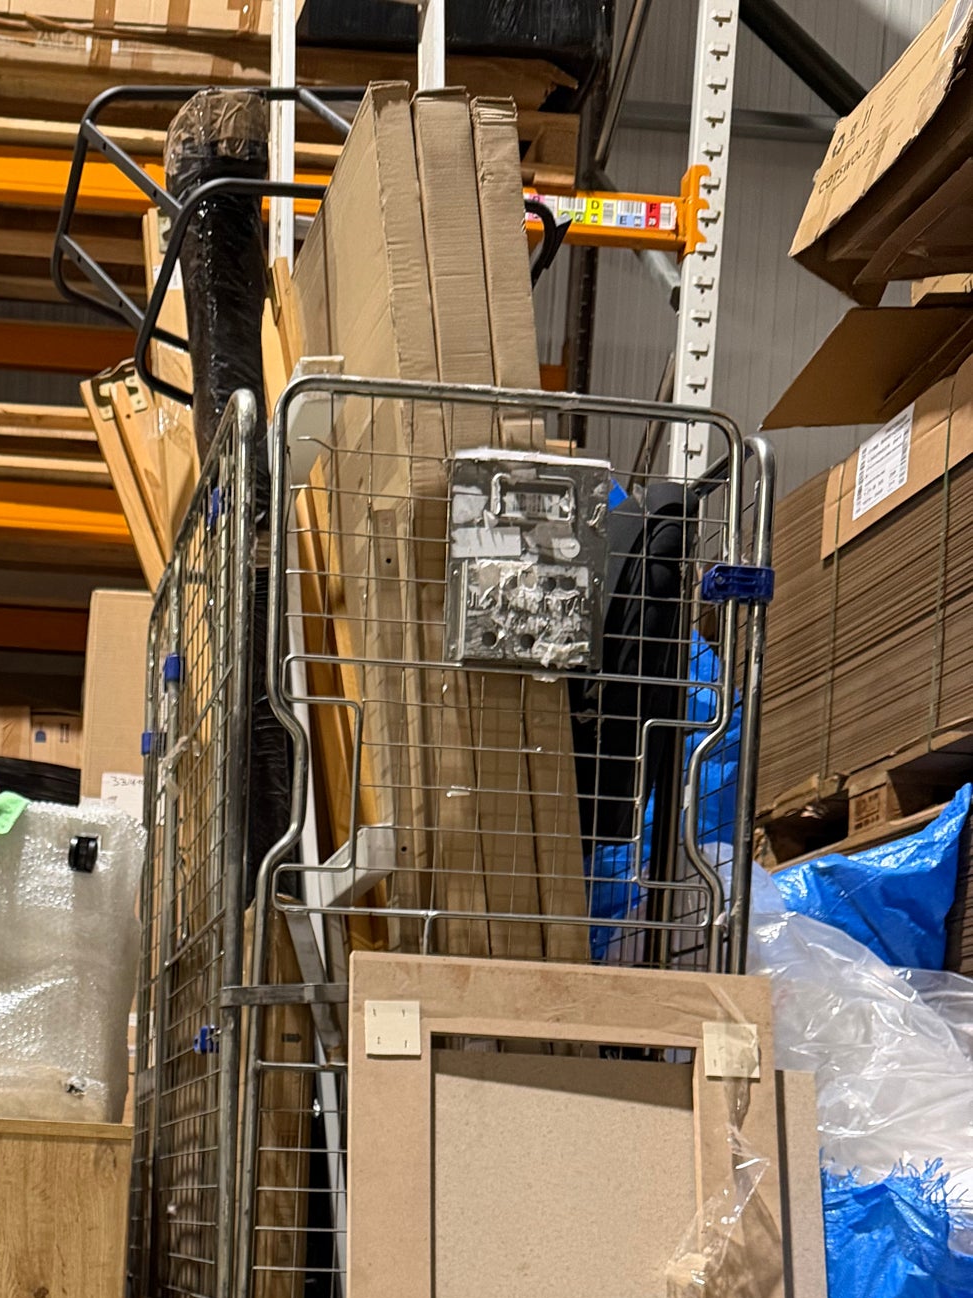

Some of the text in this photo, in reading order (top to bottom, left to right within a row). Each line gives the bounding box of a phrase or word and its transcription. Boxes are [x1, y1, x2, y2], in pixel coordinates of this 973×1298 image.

[591, 200, 600, 210] D
[649, 203, 657, 213] F
[619, 215, 627, 225] E
